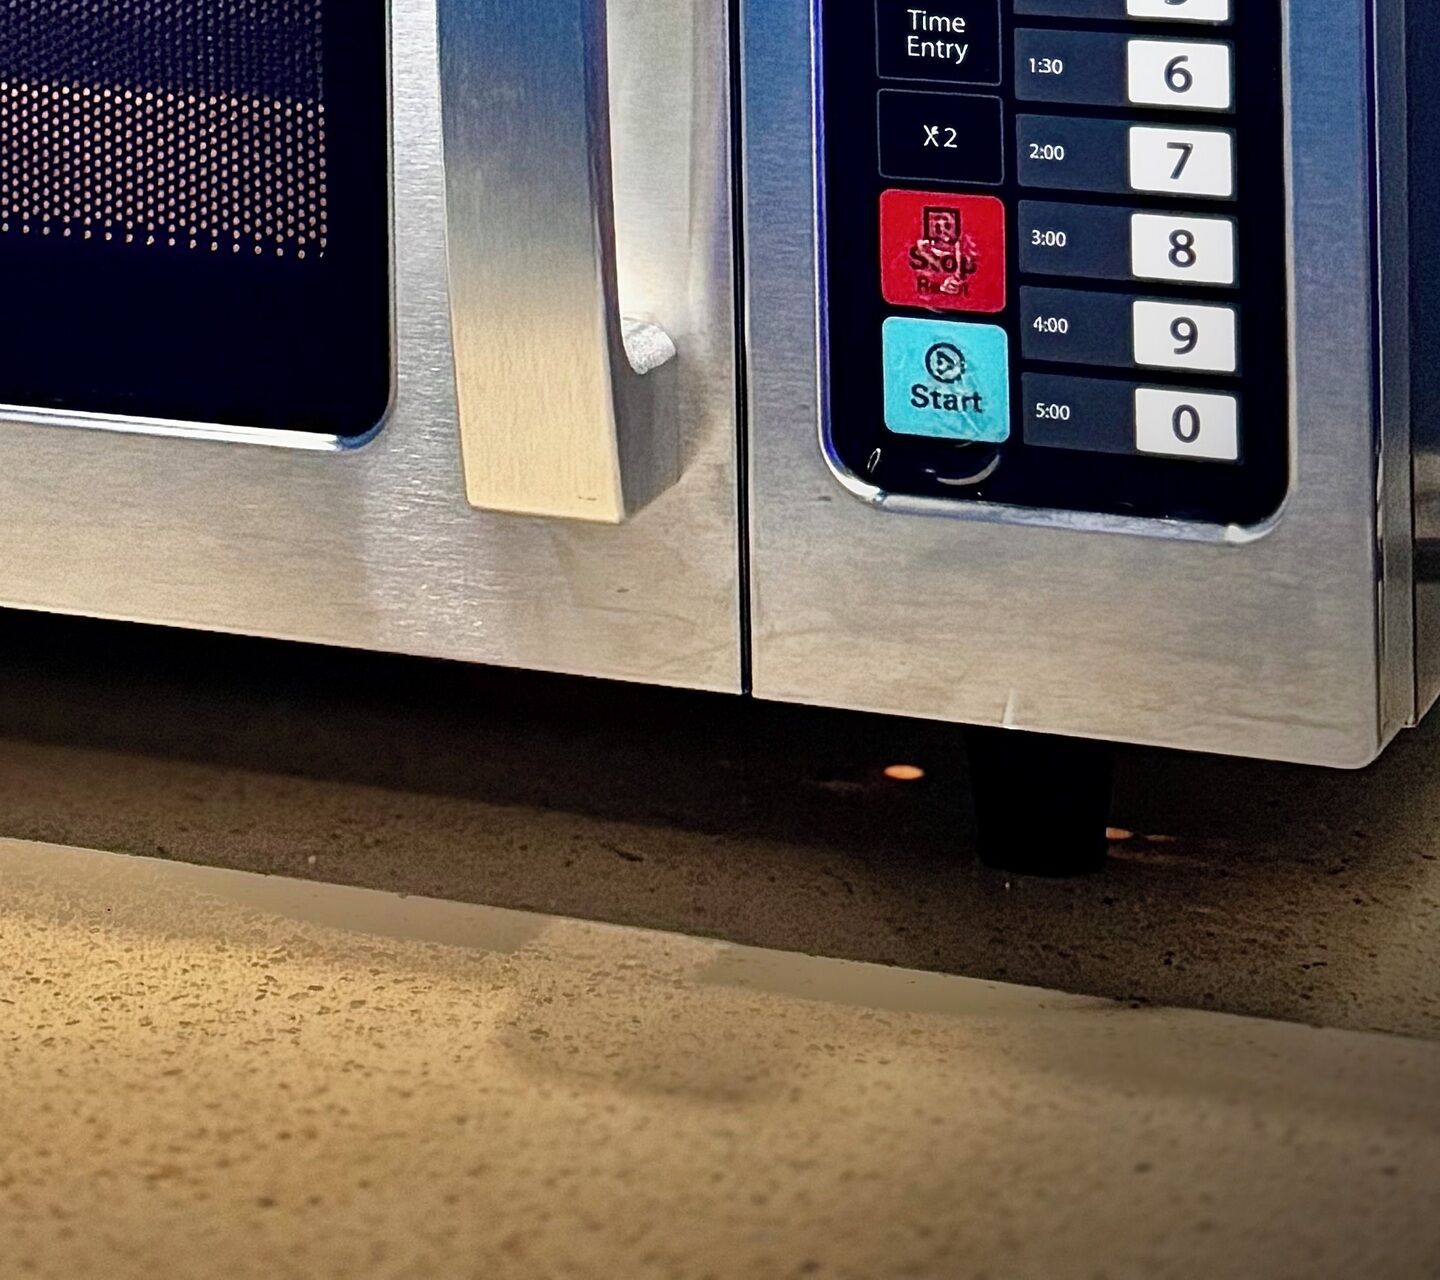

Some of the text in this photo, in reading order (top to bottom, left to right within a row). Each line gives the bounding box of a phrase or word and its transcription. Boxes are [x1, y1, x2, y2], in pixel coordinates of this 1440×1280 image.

[907, 9, 966, 33] Time
[907, 35, 969, 64] Entry
[1029, 57, 1063, 75] 1:30
[1164, 55, 1193, 93] 6
[923, 124, 958, 148] X 2
[1029, 143, 1064, 161] 2:00
[1166, 142, 1193, 180] 7
[1031, 229, 1067, 248] 3:00
[1168, 229, 1197, 268] 8
[1032, 316, 1069, 334] 4:00
[1170, 317, 1199, 355] 9
[910, 383, 983, 414] Start
[1035, 402, 1071, 421] 5:00
[1172, 404, 1201, 444] 0
